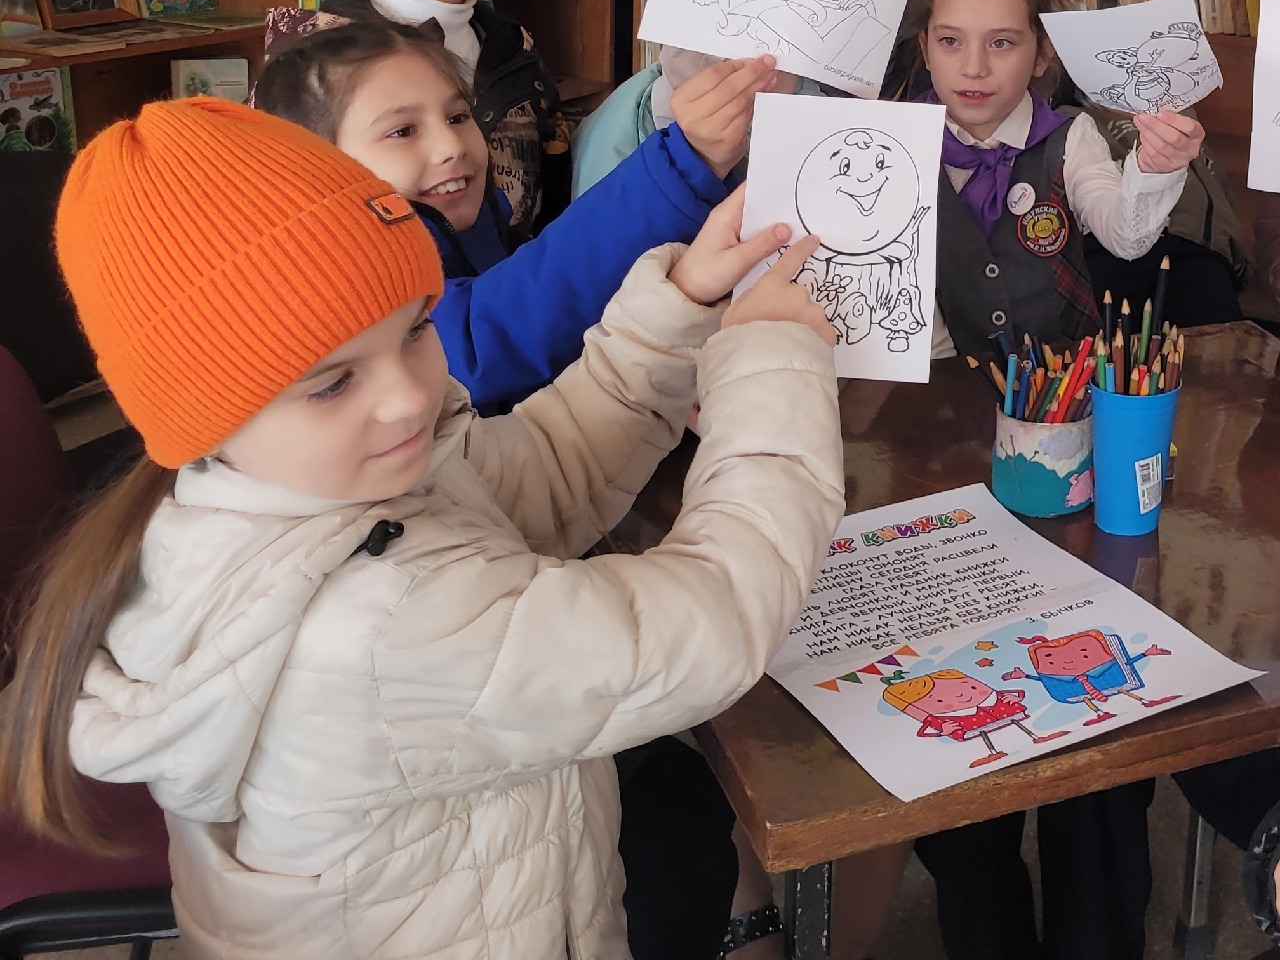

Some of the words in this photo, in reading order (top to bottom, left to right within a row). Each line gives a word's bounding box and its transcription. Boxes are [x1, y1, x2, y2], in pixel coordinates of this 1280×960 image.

[861, 508, 976, 547] КНИЖКИ
[810, 577, 863, 595] ЕННЕМУ
[869, 560, 930, 579] СЕГОДНЯ
[933, 543, 999, 563] РАСЦВЕЛИ
[820, 553, 889, 575] КЛОКОЧУТ
[895, 542, 938, 557] ВОДЫ,
[939, 529, 988, 546] ЗВОНКО
[800, 605, 821, 615] НЬ
[828, 590, 876, 607] ЛЮБЯТ
[882, 572, 952, 593] ПРАЗДНИК
[955, 556, 1010, 575] КНИЖКИ
[842, 581, 884, 595] ГЛАЗА
[915, 587, 957, 602] КНИГА
[973, 568, 1030, 588] ПЕРВЫЙ,
[806, 636, 840, 649] НАМ
[845, 621, 895, 639] НИКАК
[897, 607, 951, 624] НЕЛЬЗЯ
[955, 598, 981, 610] БЕЗ
[983, 582, 1044, 602] КНИЖКИ,
[806, 645, 841, 659] НАМ
[845, 631, 896, 648] НИКАК
[898, 615, 953, 634] НЕЛЬЗЯ
[956, 608, 983, 620] БЕЗ
[986, 590, 1046, 610] КНИЖКИ!
[812, 621, 858, 638] КНИГА
[878, 601, 937, 620] ЛУЧШИЙ
[942, 591, 971, 605] ДРУГ
[820, 595, 898, 618] ДЕВЧОНКИ,
[1040, 599, 1095, 619] БЫЧКОВ
[871, 639, 901, 651] ВСЕ
[905, 622, 960, 642] РЕБЯТА
